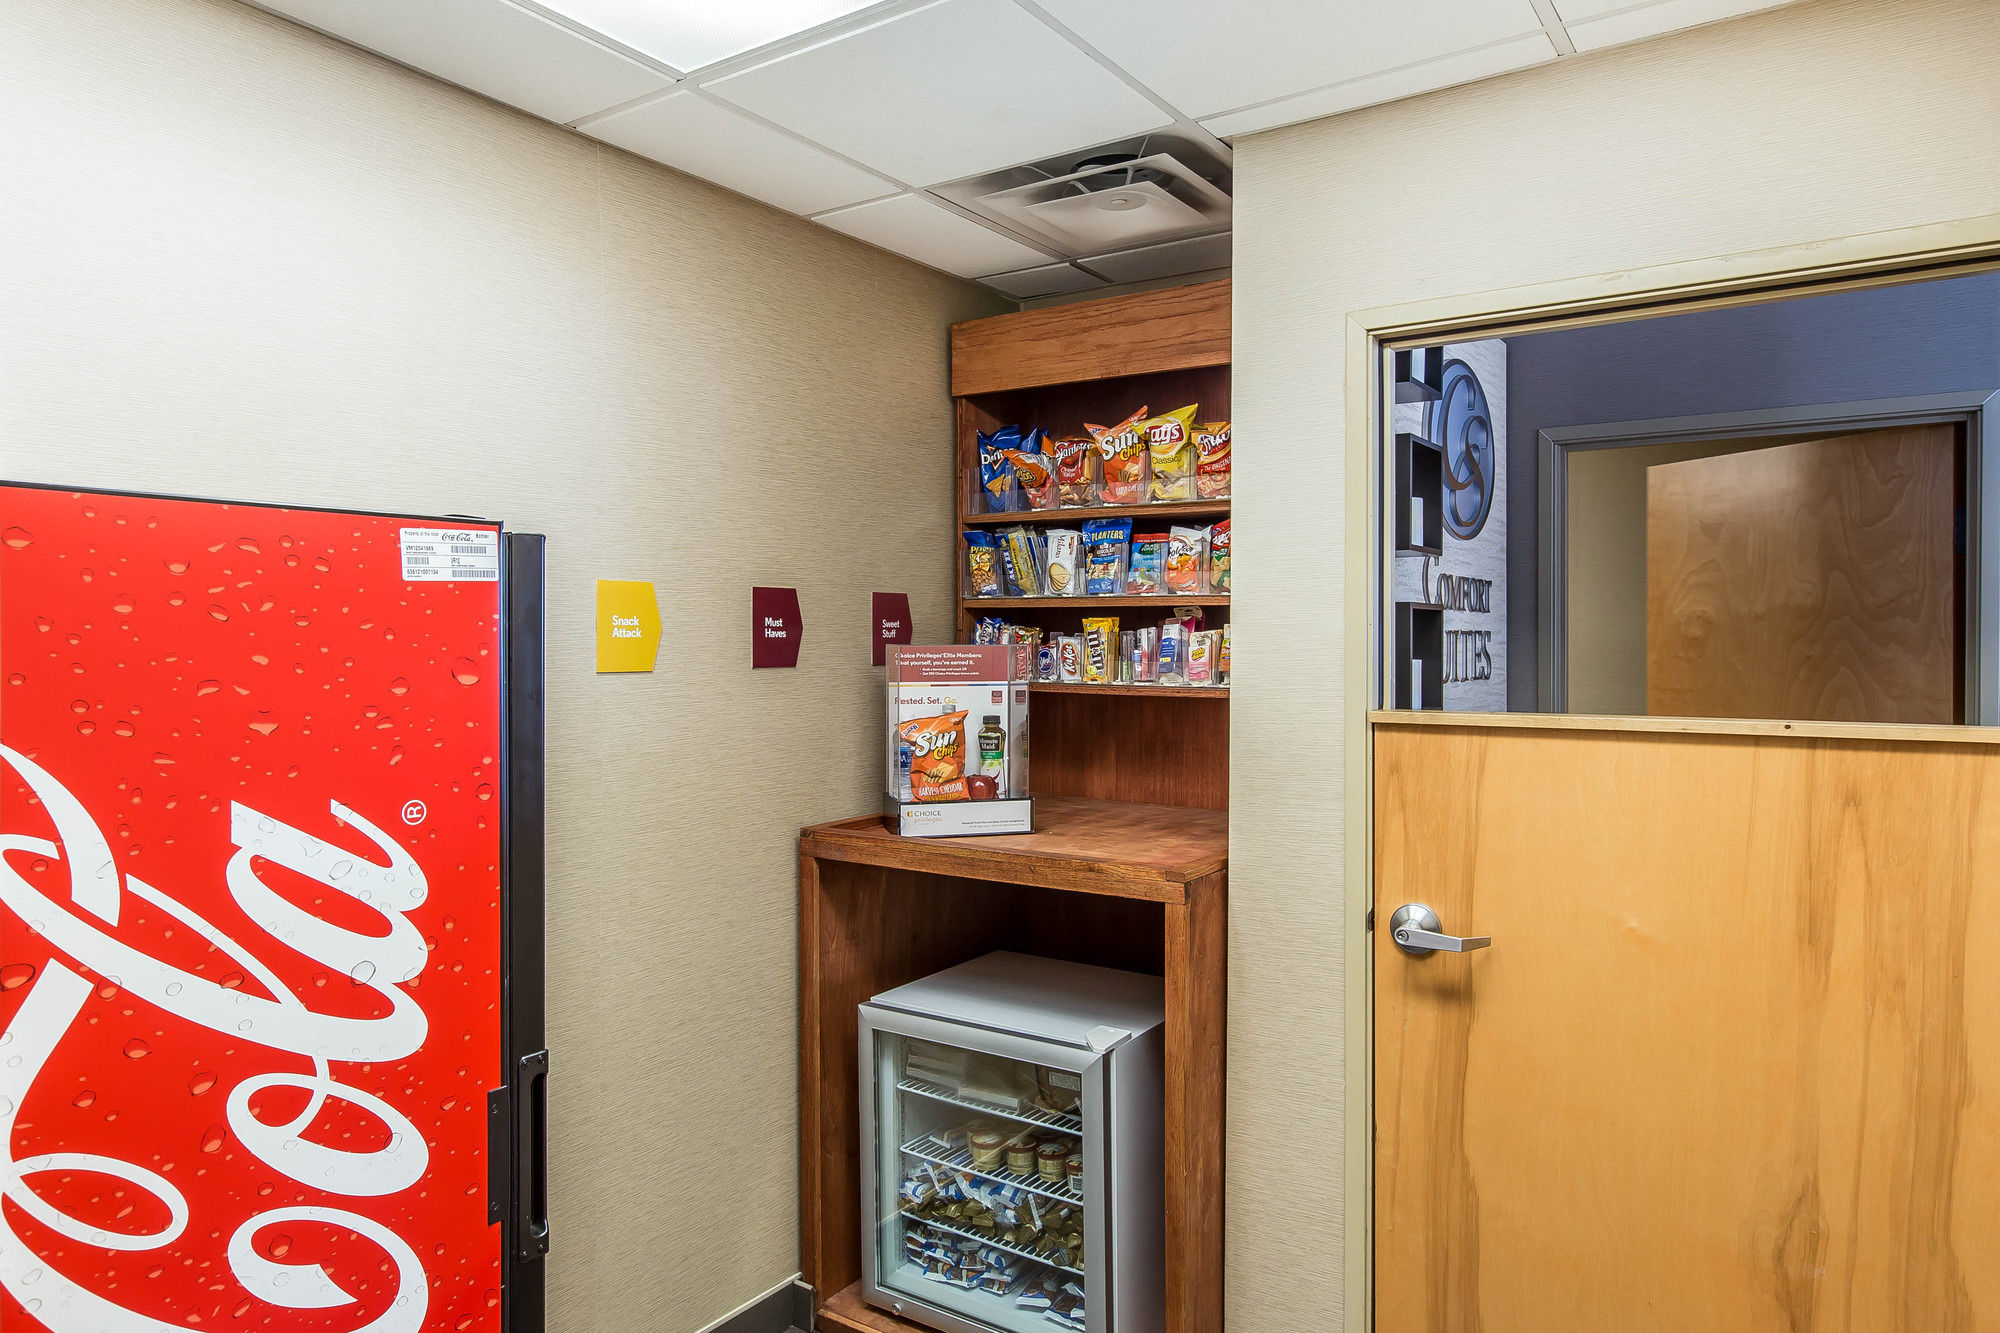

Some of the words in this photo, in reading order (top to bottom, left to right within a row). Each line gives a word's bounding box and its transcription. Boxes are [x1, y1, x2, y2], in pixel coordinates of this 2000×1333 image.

[1101, 431, 1139, 461] Sun
[1119, 441, 1146, 461] Chips
[1152, 456, 1179, 465] Classic
[1091, 530, 1124, 542] PLANTERS
[1422, 555, 1492, 613] COMFORT
[612, 615, 640, 626] Snack
[764, 617, 783, 627] Must
[882, 619, 900, 628] Sweet
[612, 627, 642, 638] Attack
[764, 628, 787, 638] Haves
[882, 629, 897, 638] Stuff
[1443, 630, 1492, 685] UITES
[927, 697, 943, 705] Set.
[943, 696, 958, 704] Go.
[915, 730, 958, 757] Sun
[933, 742, 959, 760] Chips
